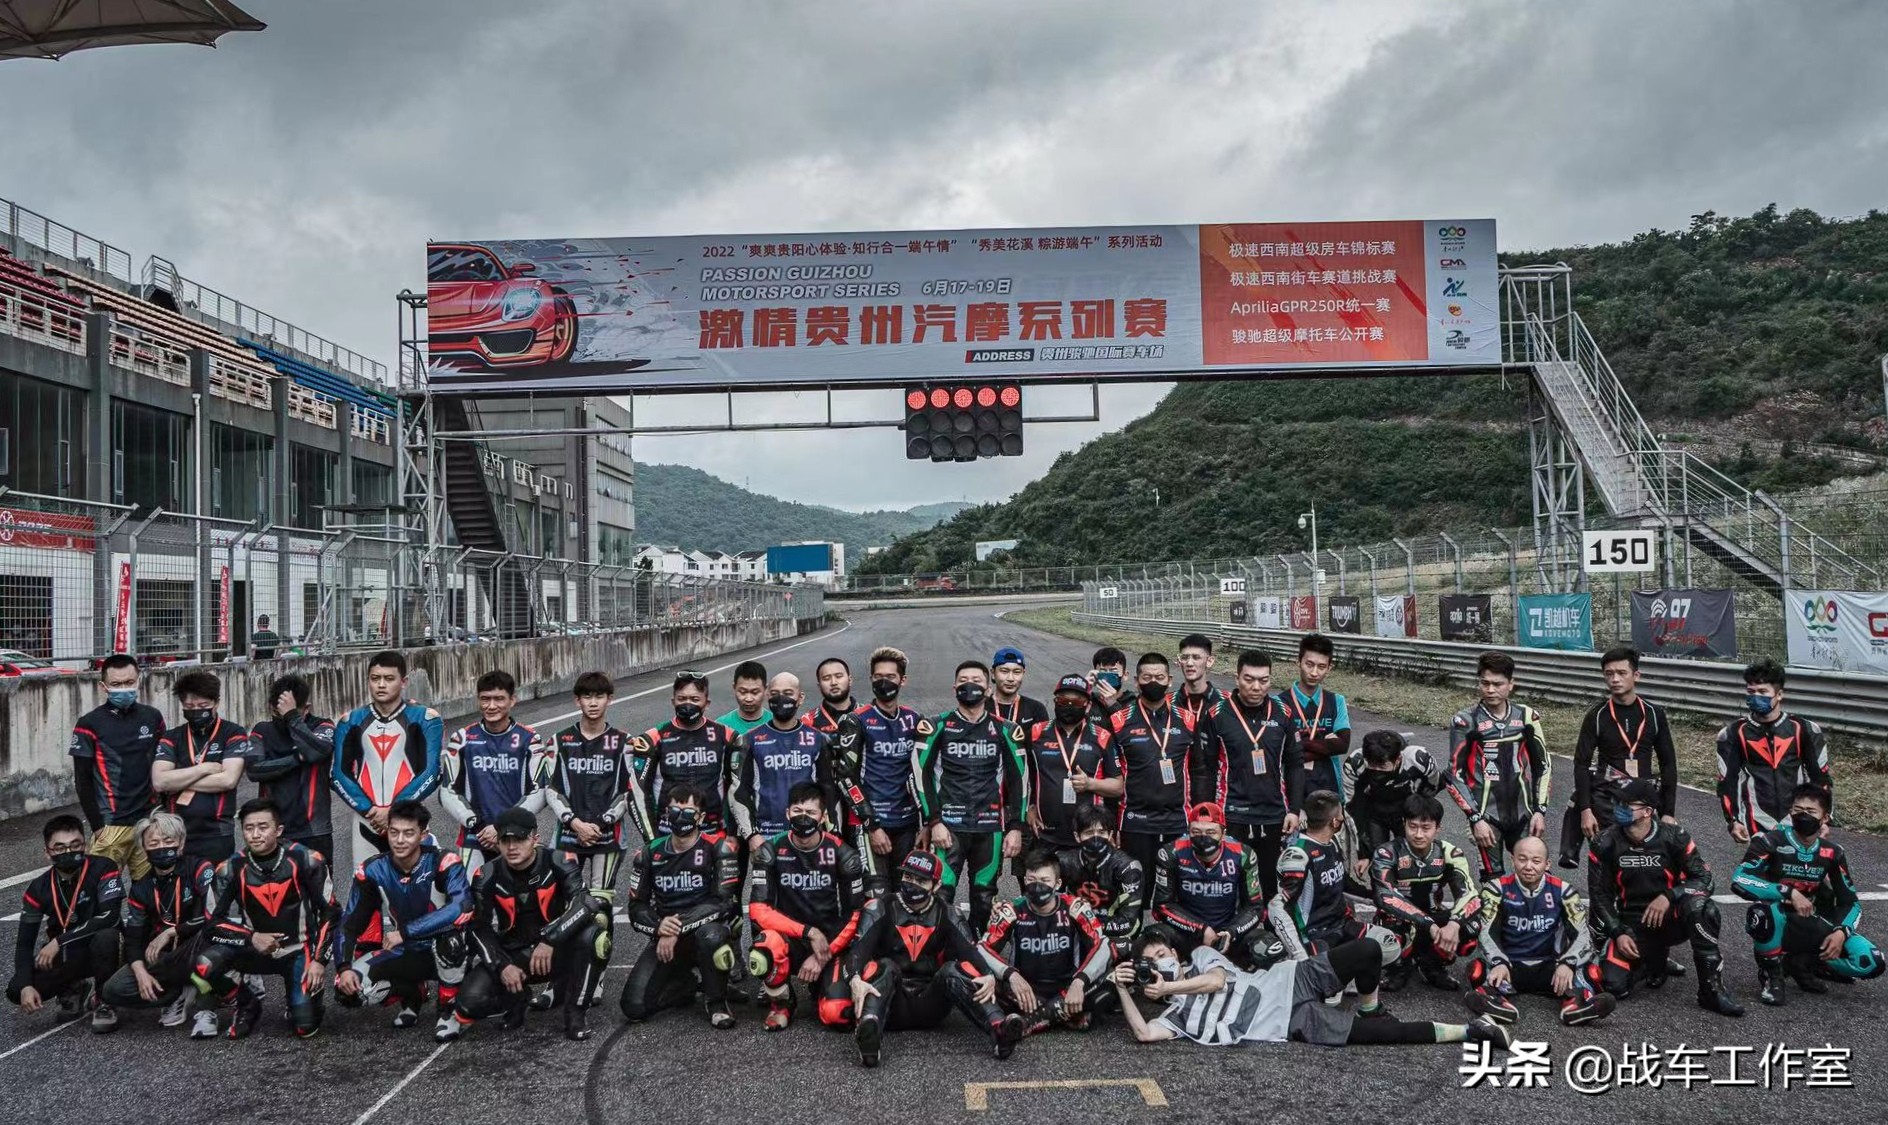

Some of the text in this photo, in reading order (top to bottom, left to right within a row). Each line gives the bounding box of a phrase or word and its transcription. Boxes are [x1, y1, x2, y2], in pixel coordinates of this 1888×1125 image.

[703, 246, 735, 258] 2022
[1107, 234, 1163, 249] 系列活动
[1229, 240, 1396, 259] 极速西南超级房车锦标赛
[702, 265, 873, 282] PASSION GUIZHOU
[1230, 269, 1398, 287] 极速西南街车赛道挑战赛
[702, 281, 900, 301] MOTORSPORT SERIES
[921, 279, 1012, 296] 6月17-19日
[1230, 297, 1392, 316] ApriliaGPR250R统一赛
[698, 298, 1168, 349] 激情贵州汽摩系列赛
[1231, 326, 1385, 345] 骏驰超级摩托车公开赛
[972, 351, 1032, 362] ADDRESS
[1589, 537, 1649, 566] 150
[1103, 589, 1114, 597] 50
[1223, 581, 1246, 592] 100
[1544, 606, 1581, 629] 凯越机车
[1062, 676, 1087, 690] aprilia
[899, 714, 915, 732] 17
[987, 720, 997, 736] 4
[511, 733, 521, 749] 3
[603, 735, 619, 750] 16
[706, 727, 717, 742] 5
[798, 731, 816, 746] 15
[664, 747, 718, 768] aprilia
[947, 739, 997, 758] aprilia
[472, 753, 519, 772] aprilia
[568, 754, 614, 774] aprilia
[764, 750, 812, 771] aprilia
[694, 849, 703, 866] 6
[818, 847, 836, 865] 19
[907, 855, 933, 872] aprilia
[1219, 859, 1236, 877] 18
[654, 871, 704, 892] aprilia
[780, 870, 832, 889] aprilia
[1182, 880, 1234, 896] aprilia
[1544, 892, 1555, 909] 9
[1236, 914, 1260, 934] Kawasaki
[1507, 914, 1556, 932] aprilia
[1020, 932, 1071, 954] aprilia
